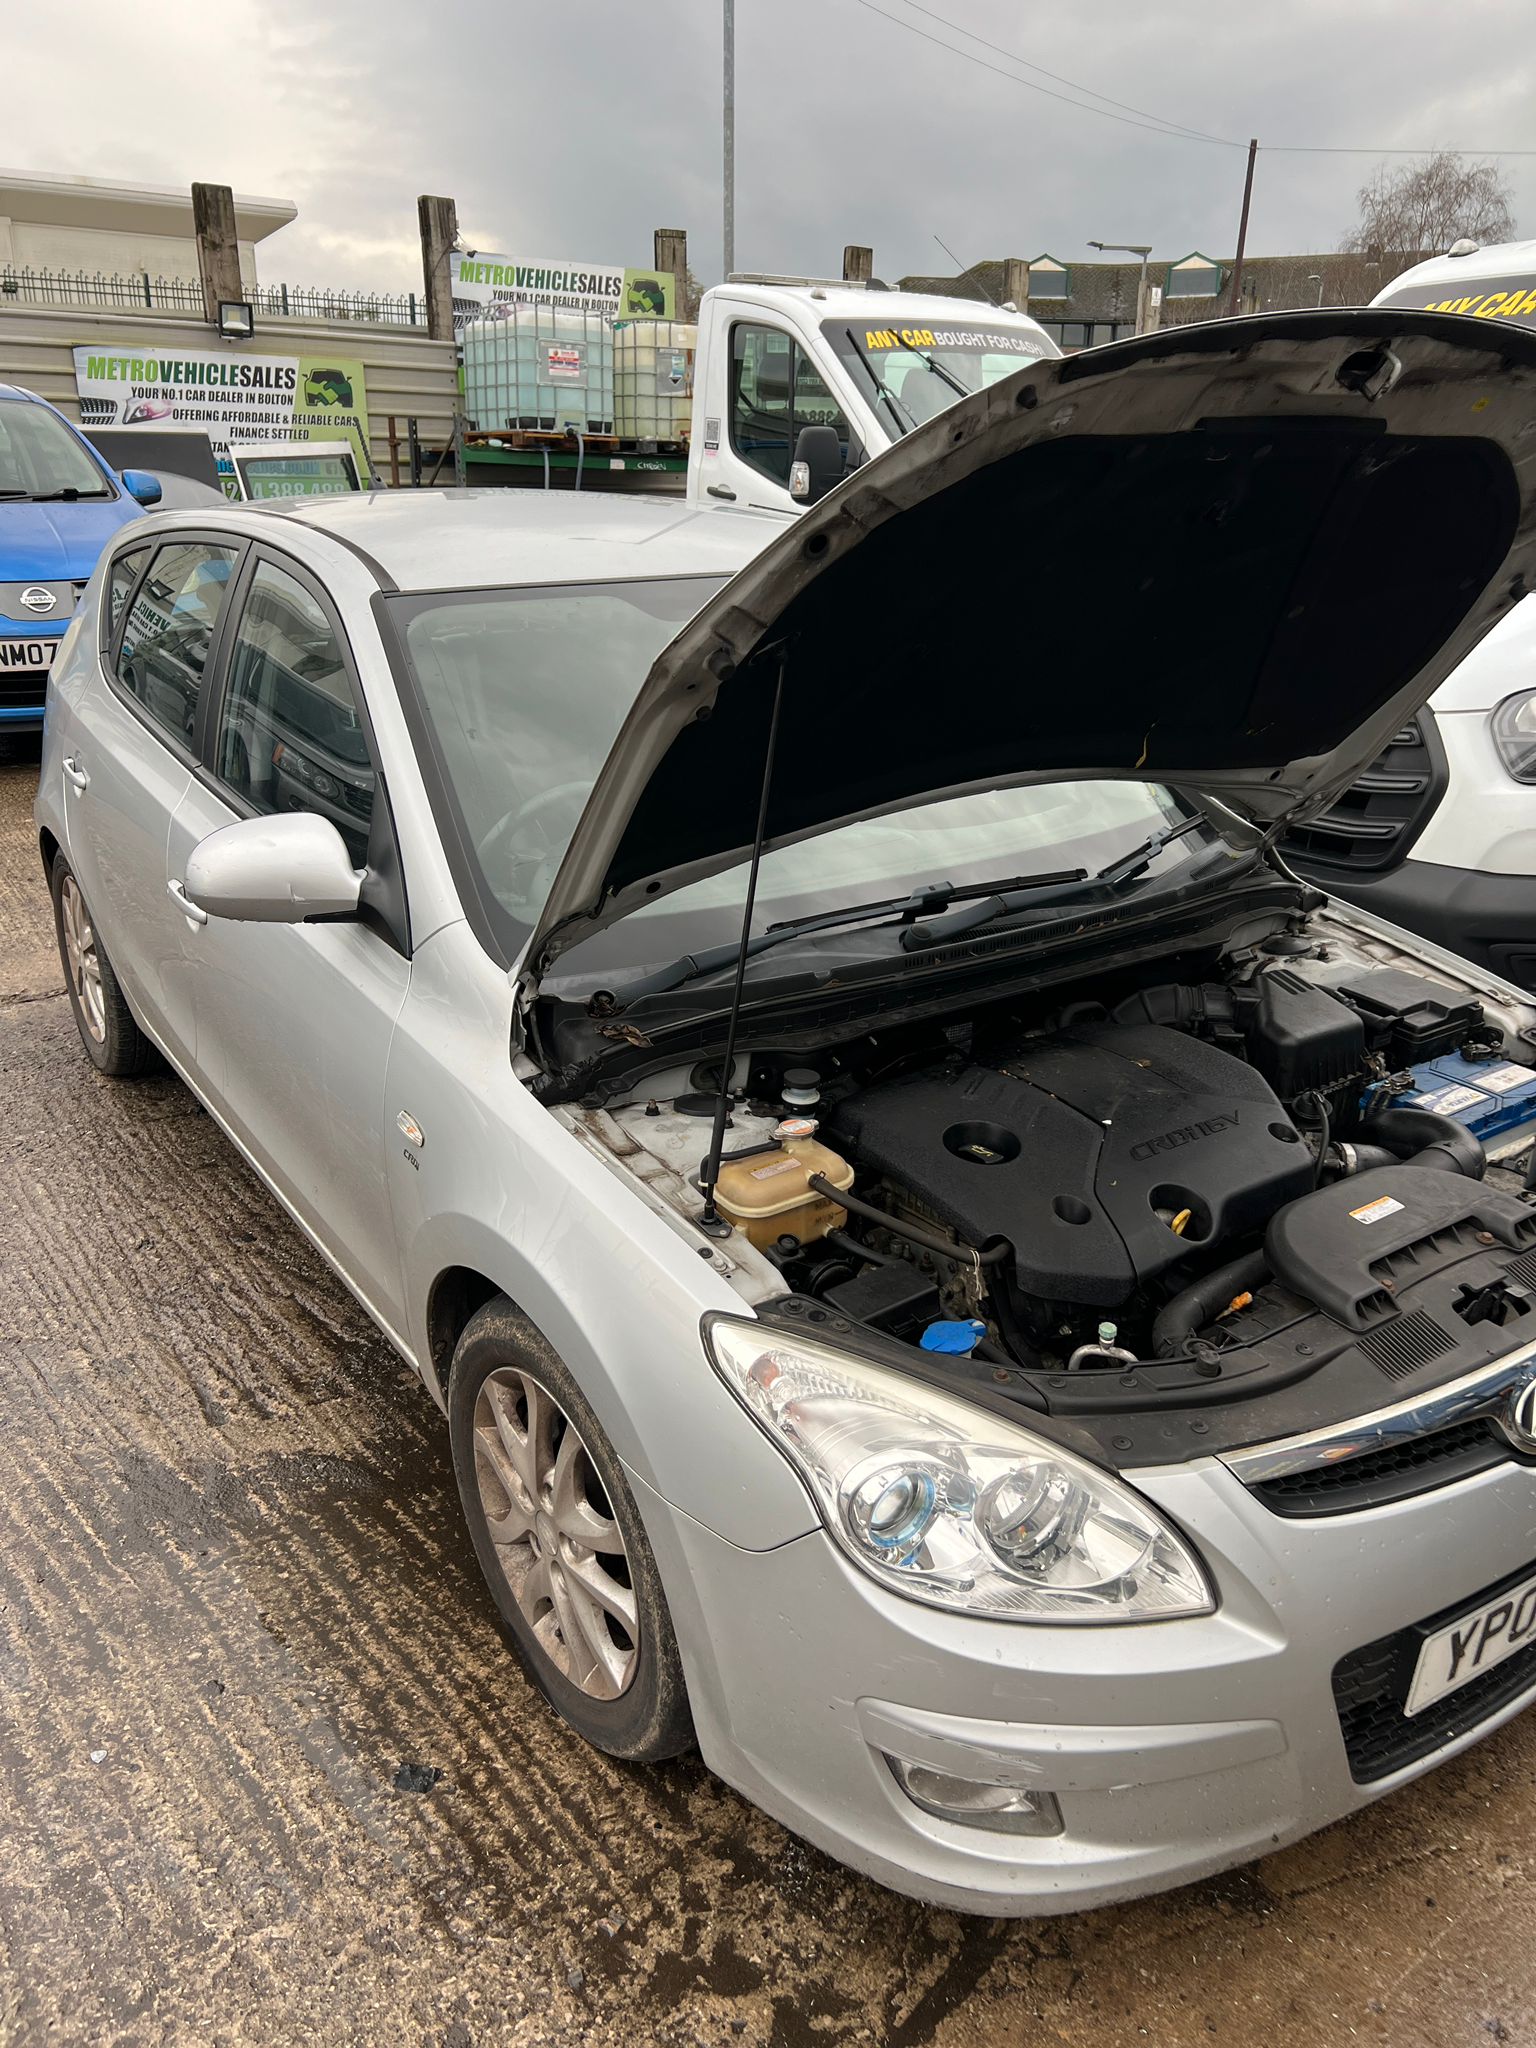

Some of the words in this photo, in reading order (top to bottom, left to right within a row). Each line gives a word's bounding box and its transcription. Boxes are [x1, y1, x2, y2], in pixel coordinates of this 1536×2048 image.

[459, 261, 622, 297] METROVEHICLESALES
[493, 289, 515, 302] YOUR
[516, 293, 533, 302] NO1
[535, 294, 551, 305] CAR
[552, 297, 581, 309] DEALER
[582, 299, 589, 309] IN
[591, 300, 619, 312] BOLTON
[865, 329, 899, 349] ANY
[903, 329, 937, 350] CAR
[934, 331, 987, 348] BOUGHT
[988, 335, 1013, 349] FOR
[87, 356, 296, 389] METROVEHICLESALES
[131, 386, 159, 399] YOUR
[161, 389, 183, 400] NO.1
[185, 390, 206, 402] CAR
[208, 391, 244, 404] DEALER
[245, 394, 255, 405] IN
[257, 394, 293, 406] BOLTON
[172, 408, 219, 422] OFFERING
[221, 411, 280, 425] AFFORDABLE
[282, 415, 289, 424] &
[291, 414, 332, 426] RELIABLE
[334, 417, 358, 427] CARS
[229, 426, 270, 439] FINANCE
[271, 428, 309, 440] SETTLED
[1447, 1588, 1536, 1682] YP0
